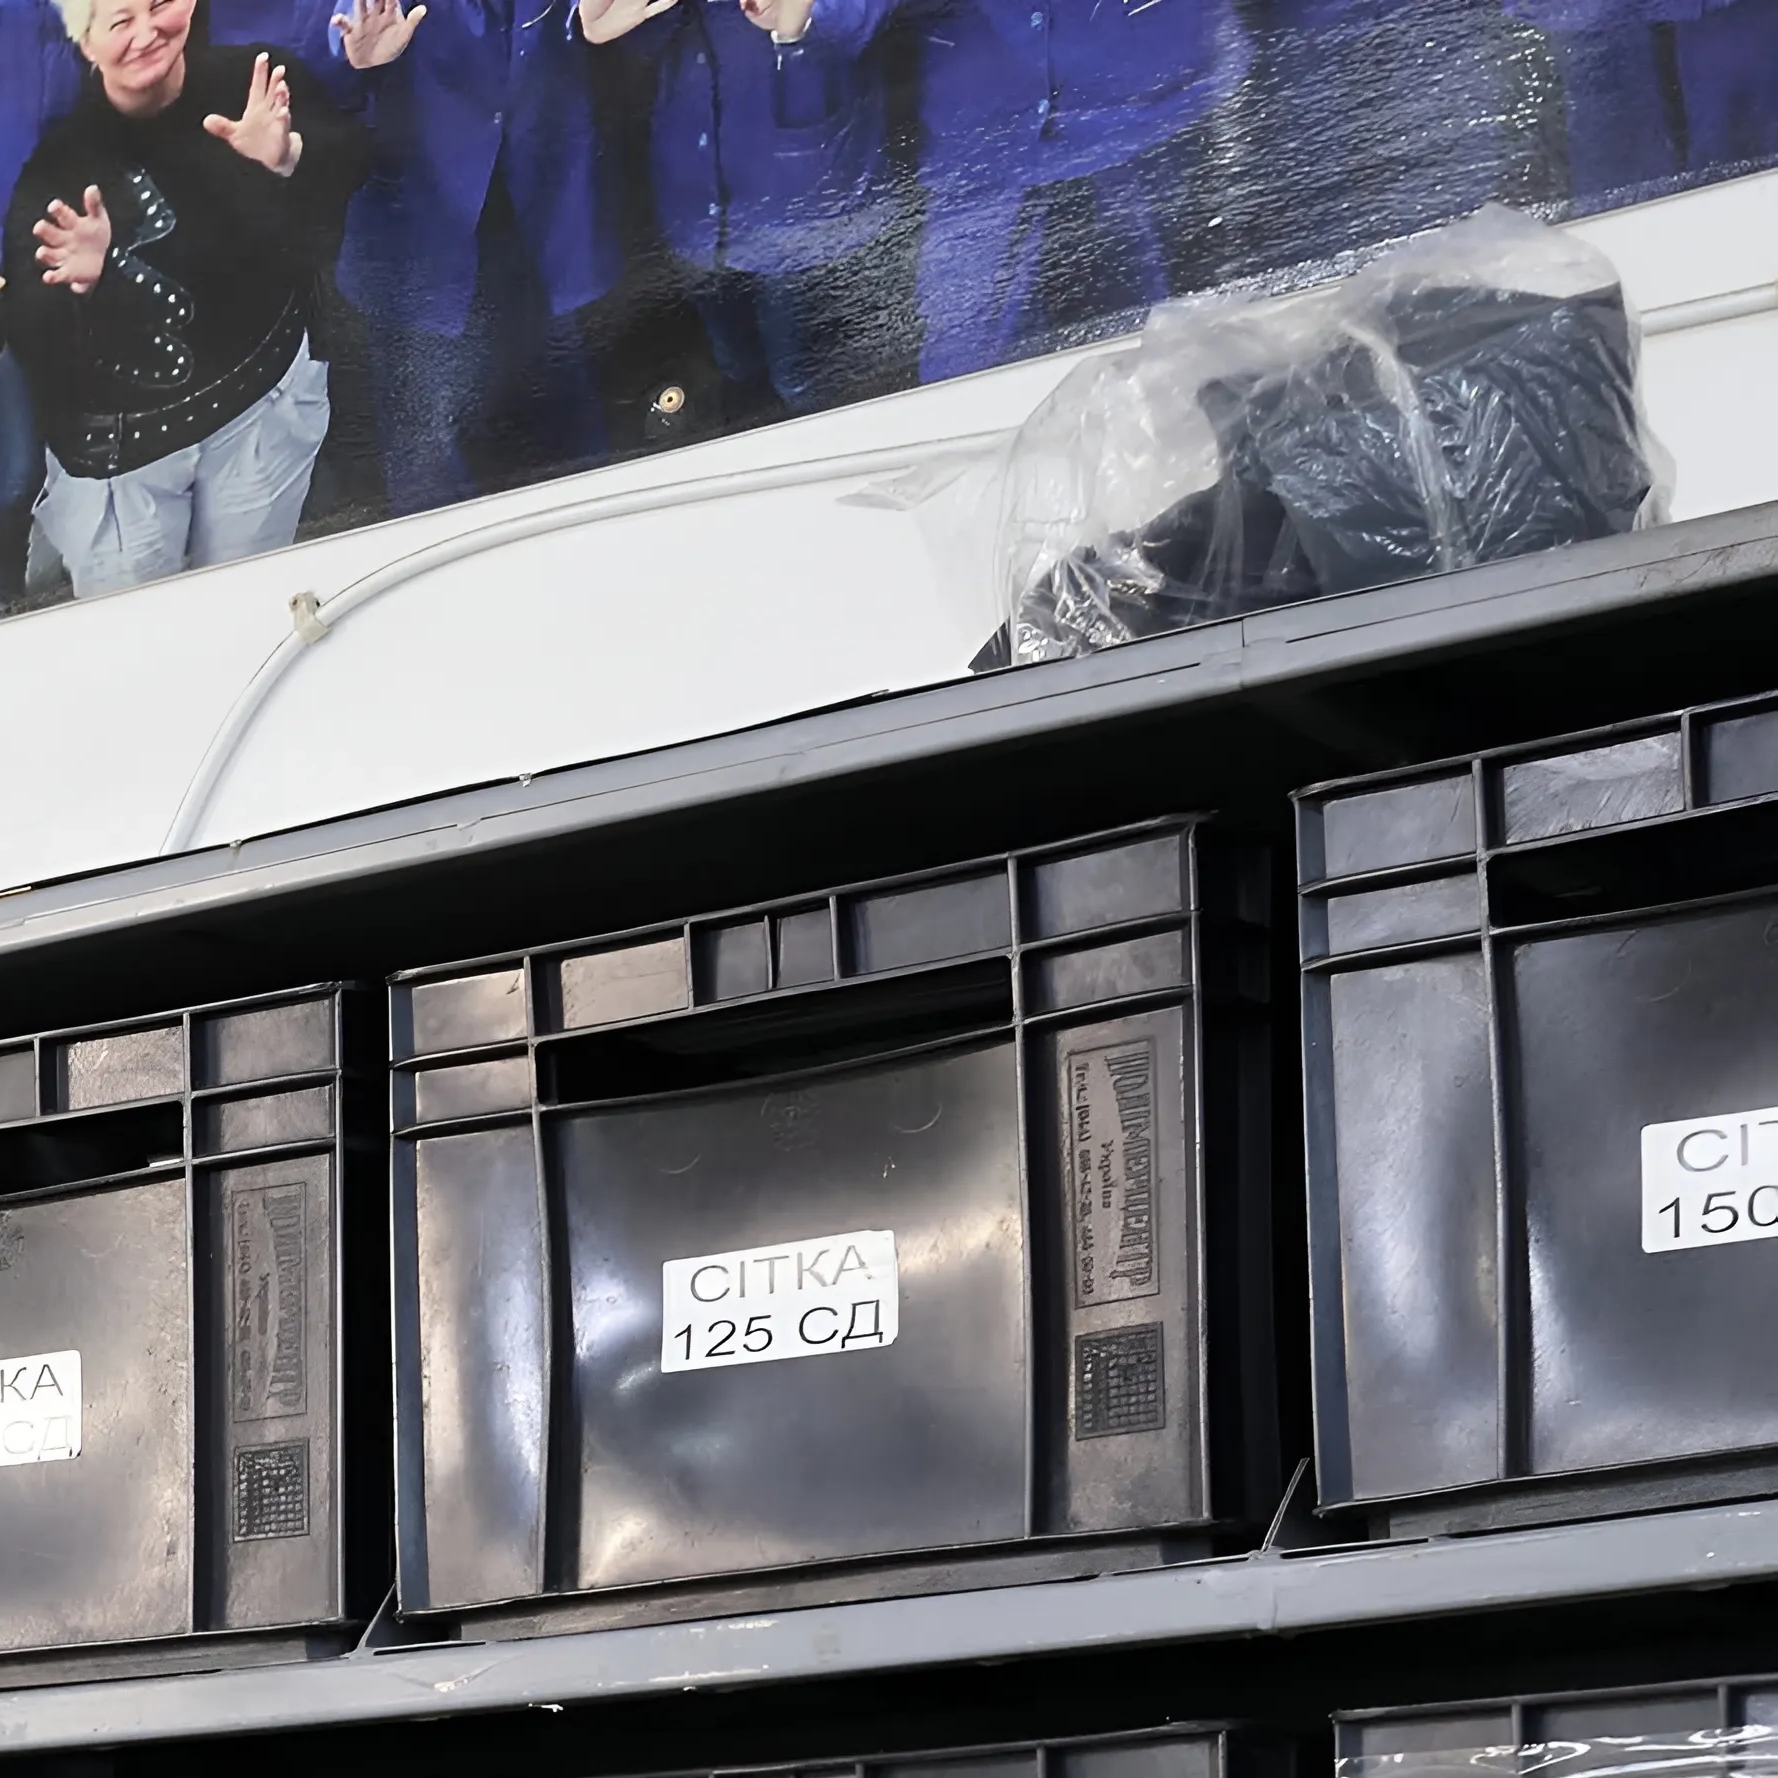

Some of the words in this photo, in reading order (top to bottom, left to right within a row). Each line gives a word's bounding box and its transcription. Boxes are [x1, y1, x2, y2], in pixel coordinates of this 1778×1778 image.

[1658, 1185, 1778, 1238] 150
[690, 1245, 872, 1302] СІТКА
[674, 1315, 772, 1360] 125
[799, 1300, 883, 1348] СД
